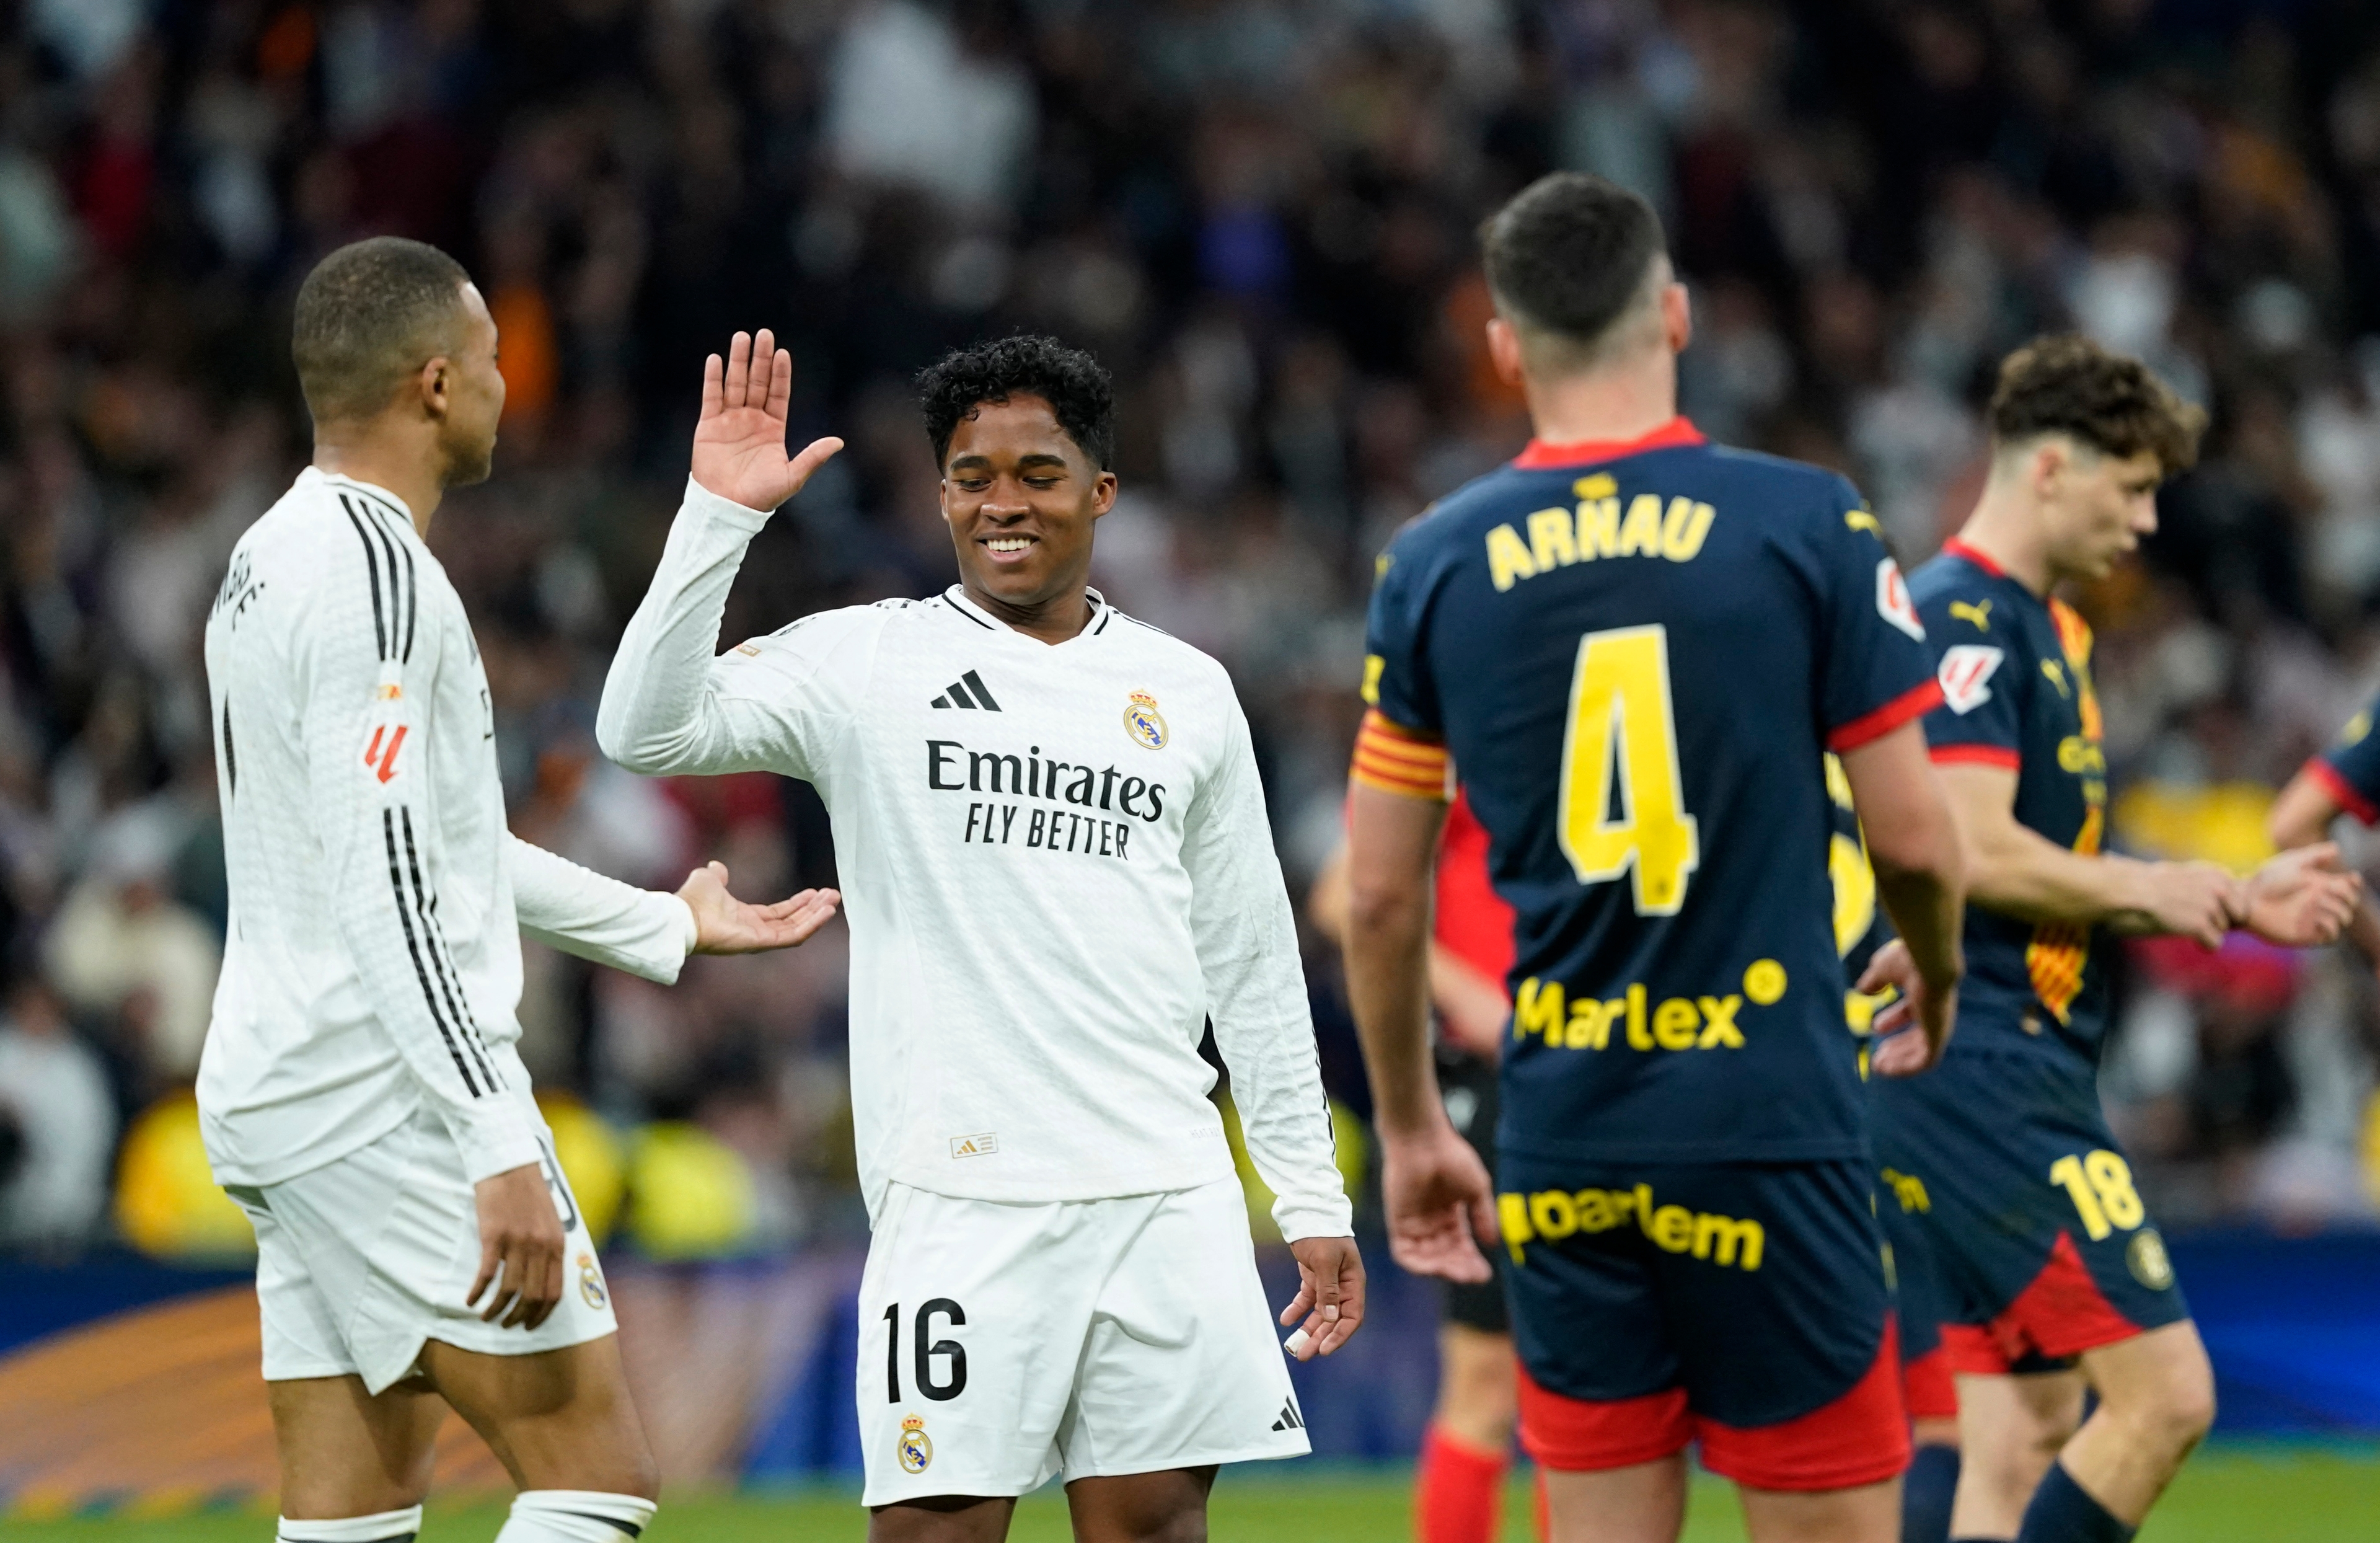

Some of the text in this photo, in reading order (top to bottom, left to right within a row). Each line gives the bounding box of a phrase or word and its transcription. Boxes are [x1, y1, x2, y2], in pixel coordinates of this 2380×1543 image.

[1485, 493, 1717, 593] ARNAU
[926, 740, 1166, 822] Emirates
[1557, 623, 1699, 916] 4
[964, 803, 1129, 860] FLY BETTER
[1512, 976, 1747, 1051] Marlex
[2049, 1149, 2145, 1242] 18
[883, 1298, 967, 1404] 16
